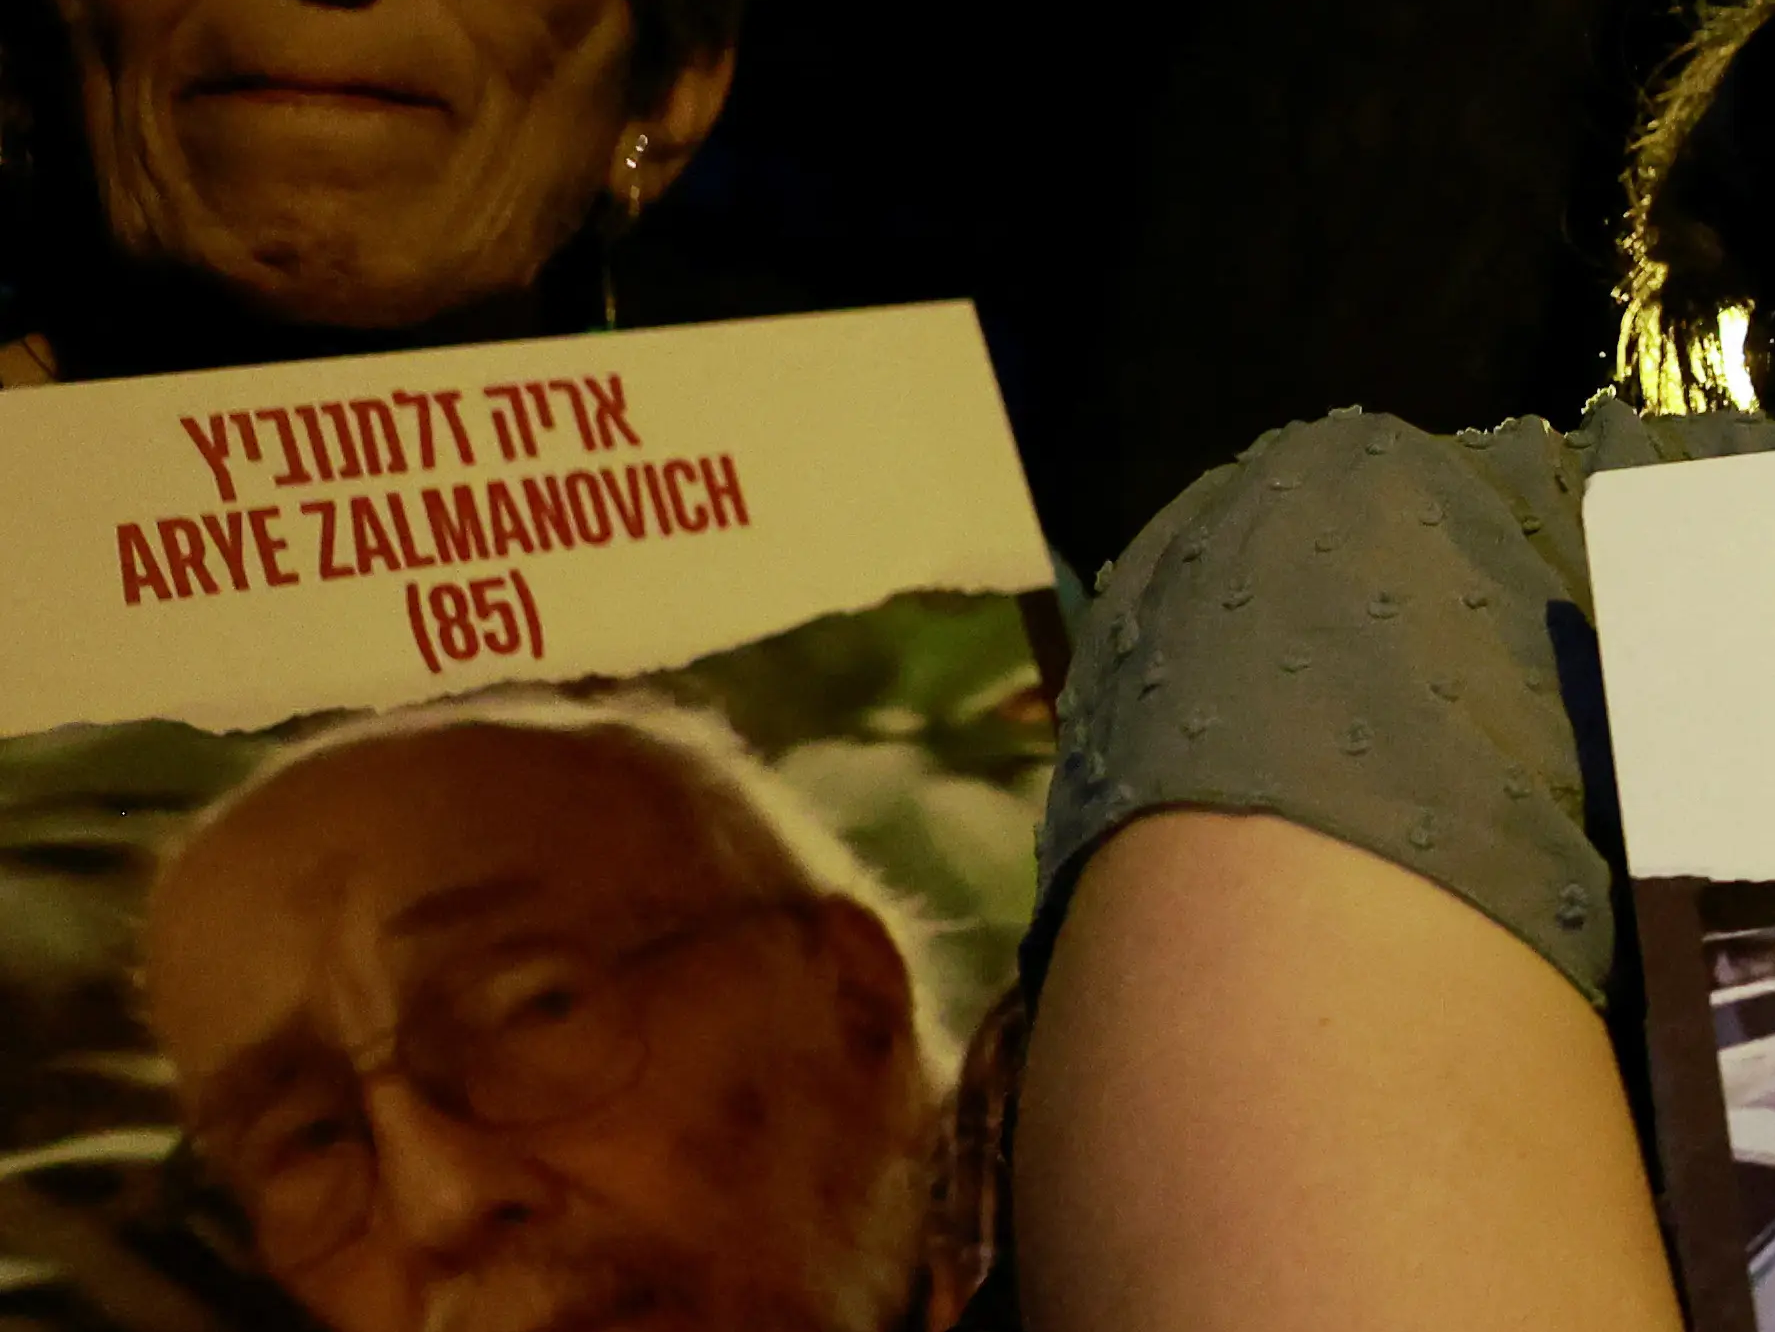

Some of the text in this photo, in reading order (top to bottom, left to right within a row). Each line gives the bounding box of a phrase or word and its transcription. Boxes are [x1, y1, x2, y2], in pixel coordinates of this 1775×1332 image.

[179, 374, 641, 503] אריה זלמנוביץ
[116, 454, 750, 606] ARYE ZALMANOVICH
[405, 569, 547, 673] (85)
